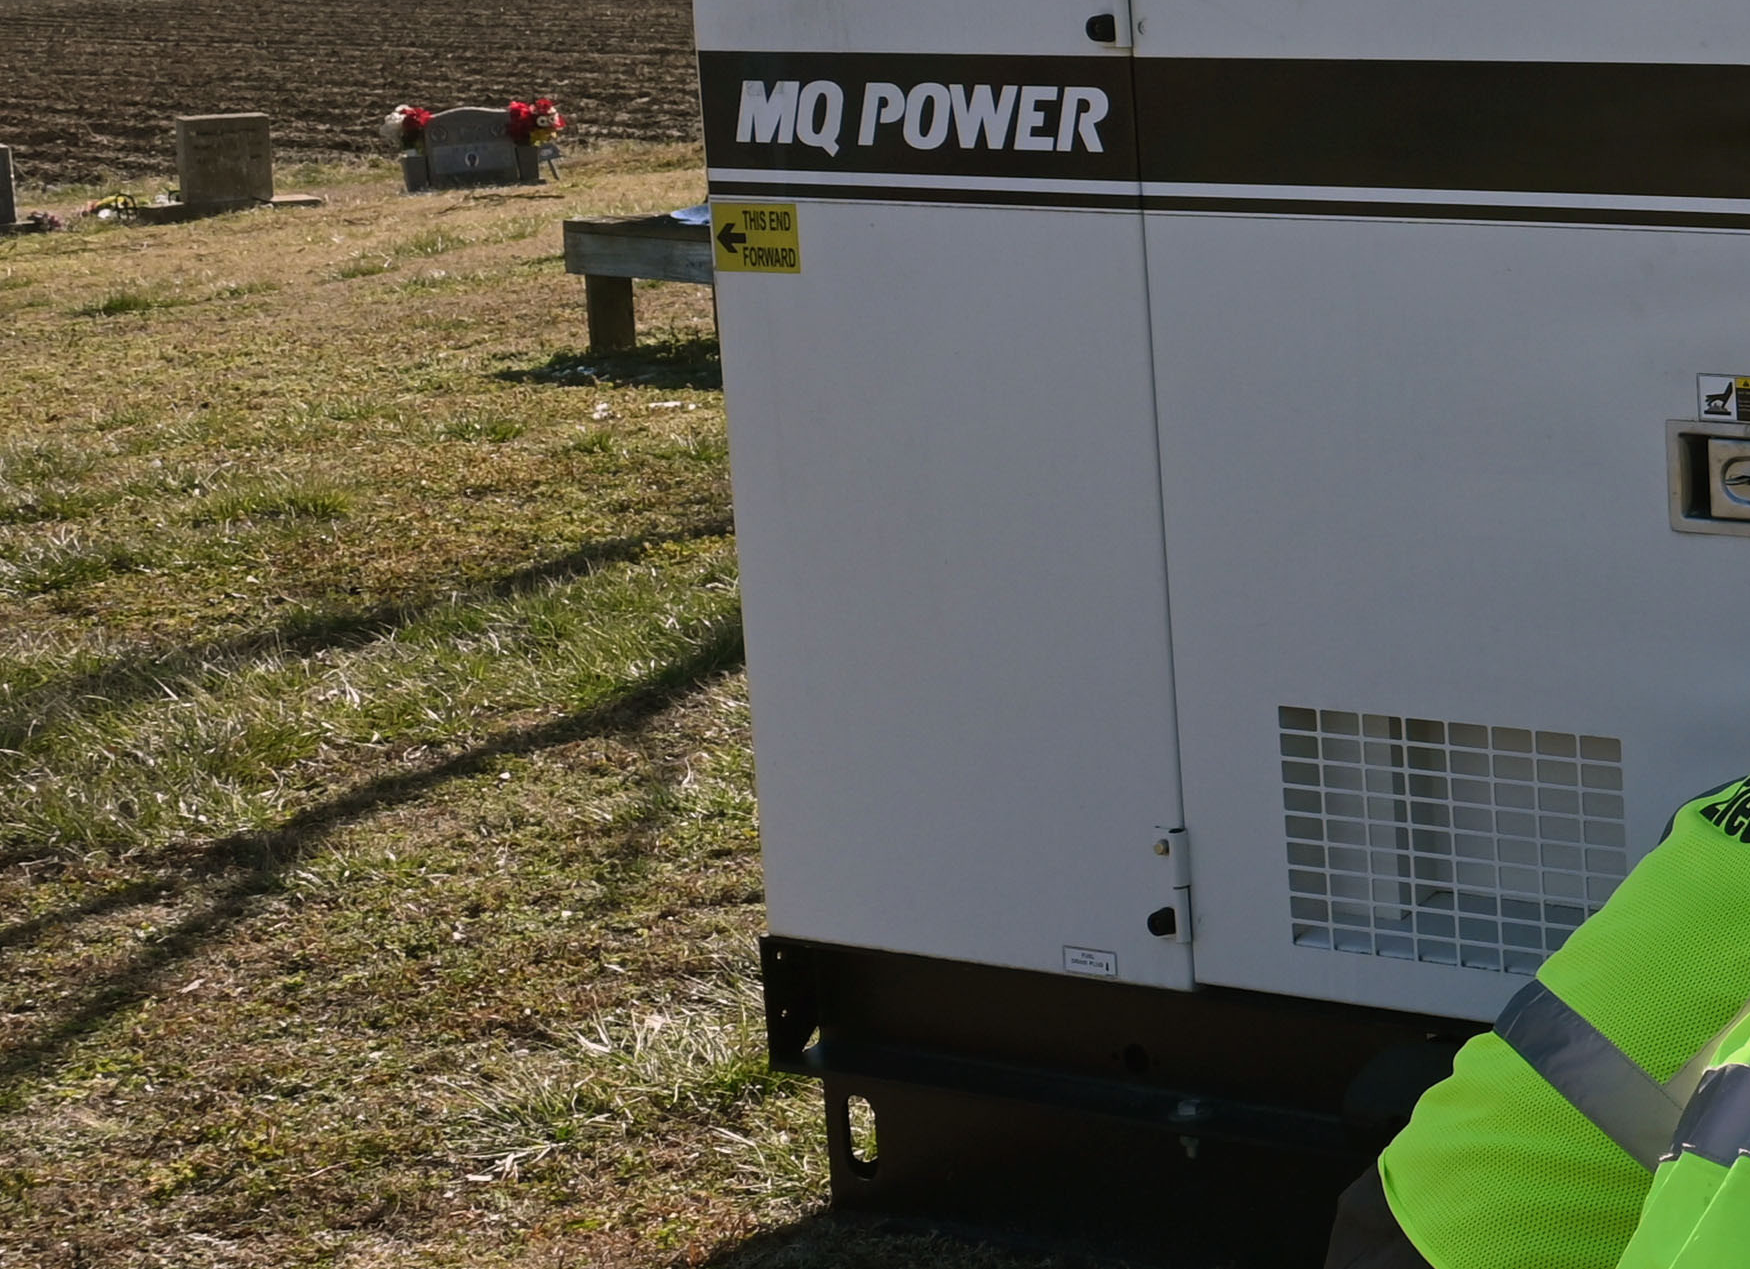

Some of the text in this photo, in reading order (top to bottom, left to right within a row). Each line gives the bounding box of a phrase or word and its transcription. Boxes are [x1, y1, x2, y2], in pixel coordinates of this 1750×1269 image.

[736, 80, 1109, 157] MQ POWER
[742, 210, 791, 231] THIS END
[743, 246, 796, 268] FORWARD
